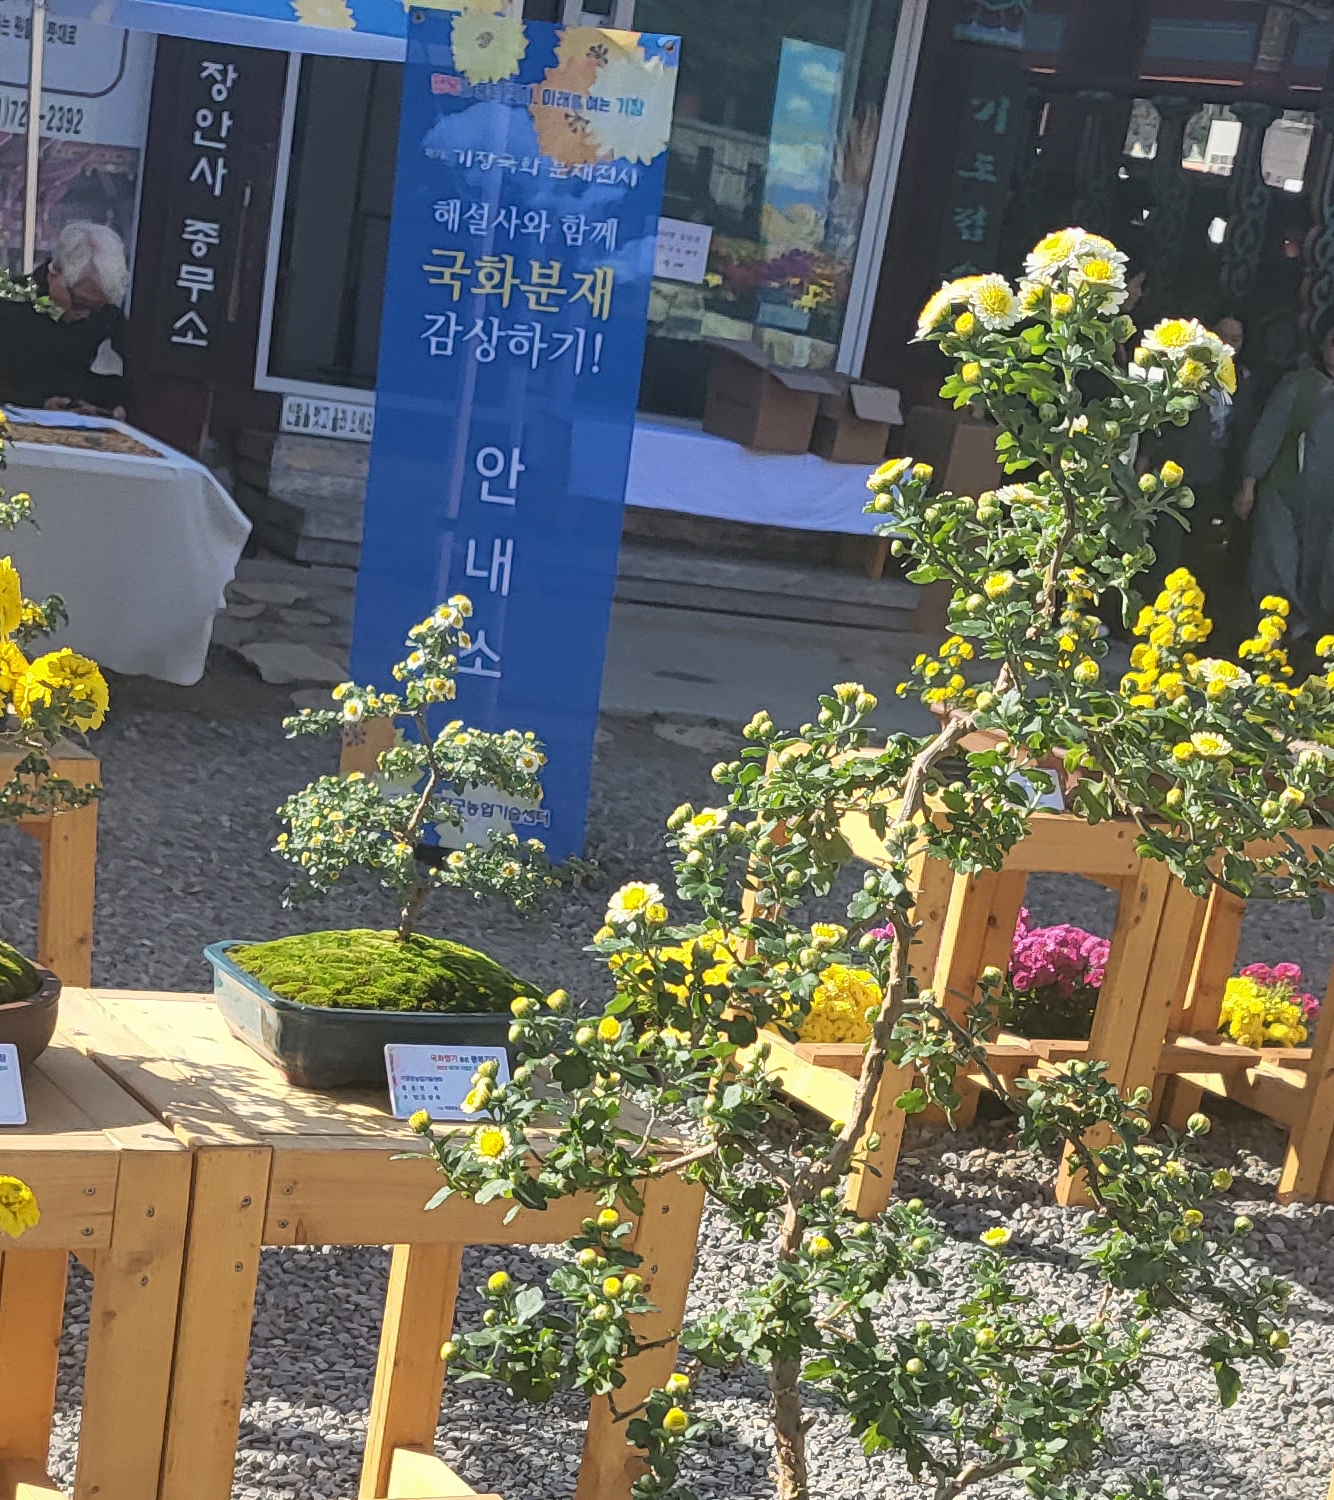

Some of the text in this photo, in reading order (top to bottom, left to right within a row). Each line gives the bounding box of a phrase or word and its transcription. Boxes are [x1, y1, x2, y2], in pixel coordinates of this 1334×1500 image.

[170, 60, 239, 347] 장안사 종무소
[548, 161, 639, 188] 분재전시
[432, 198, 551, 245] 해설사와
[560, 213, 620, 253] 함께
[421, 248, 615, 321] 국화분재
[419, 310, 604, 376] 감상하기!
[456, 445, 526, 679] 안내소
